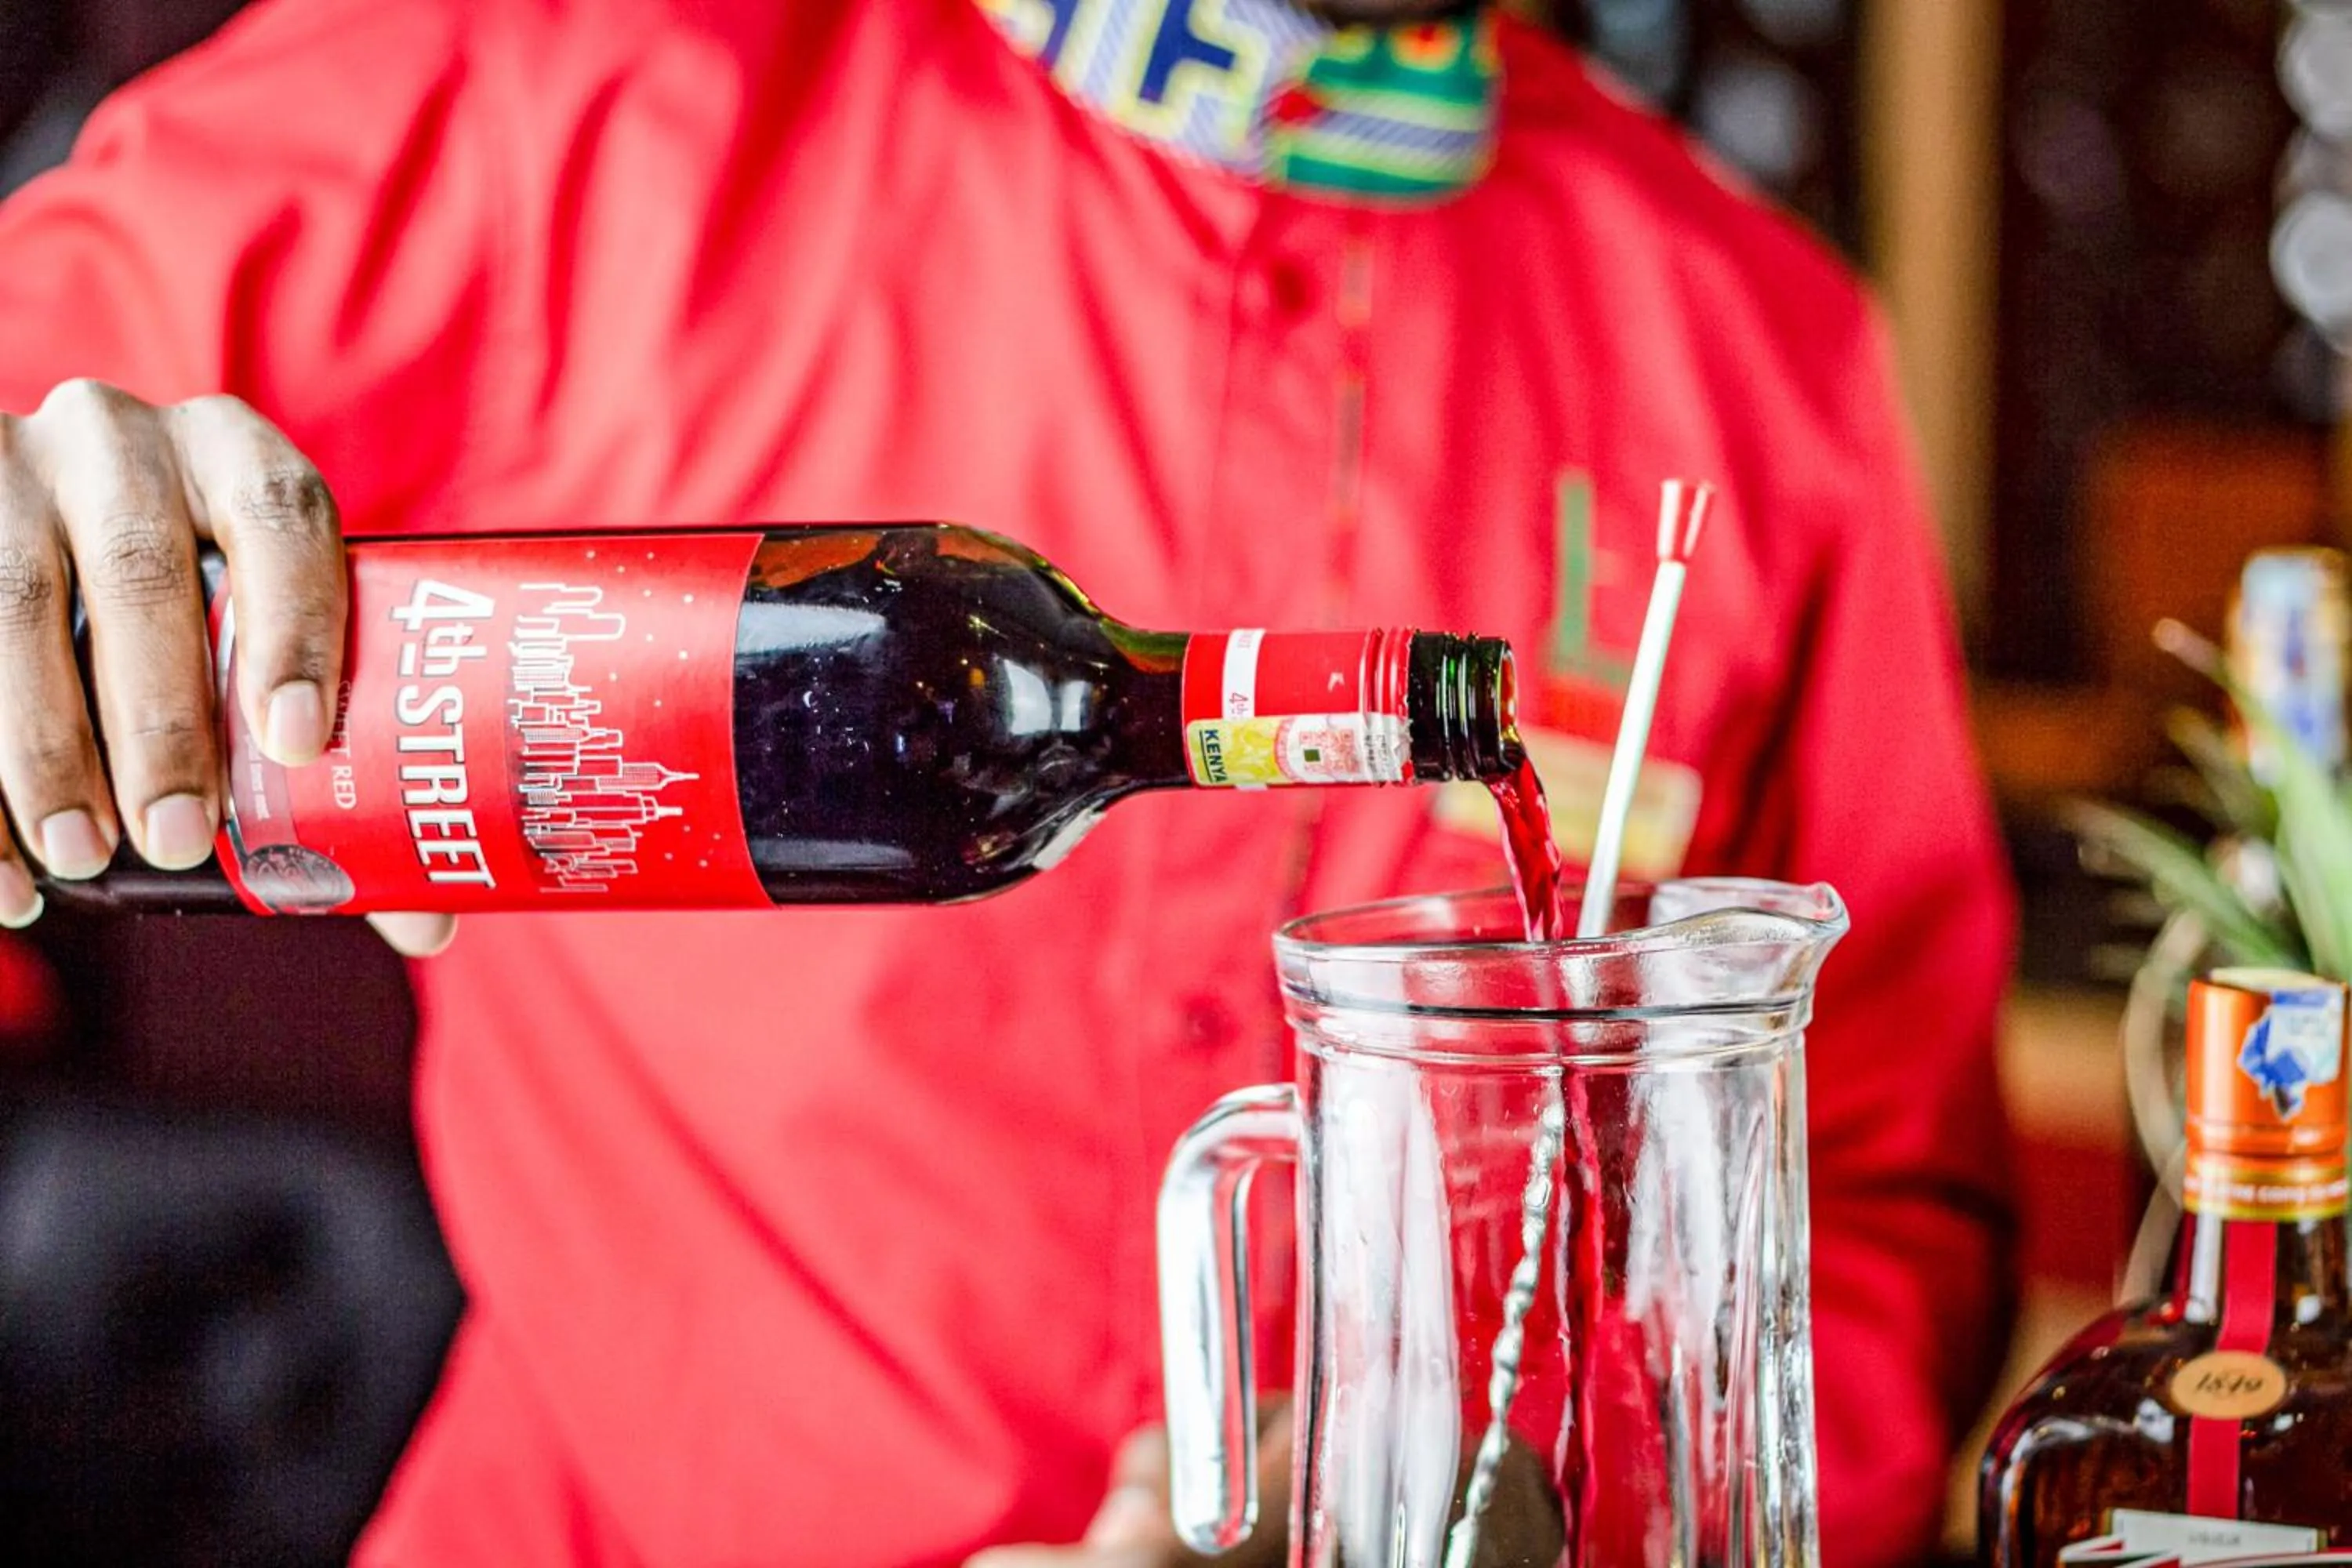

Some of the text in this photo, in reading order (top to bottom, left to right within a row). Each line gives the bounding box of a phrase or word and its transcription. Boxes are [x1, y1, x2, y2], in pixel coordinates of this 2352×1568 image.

[1204, 729, 1229, 782] KENYA
[331, 764, 358, 811] RED
[397, 684, 497, 890] STREET
